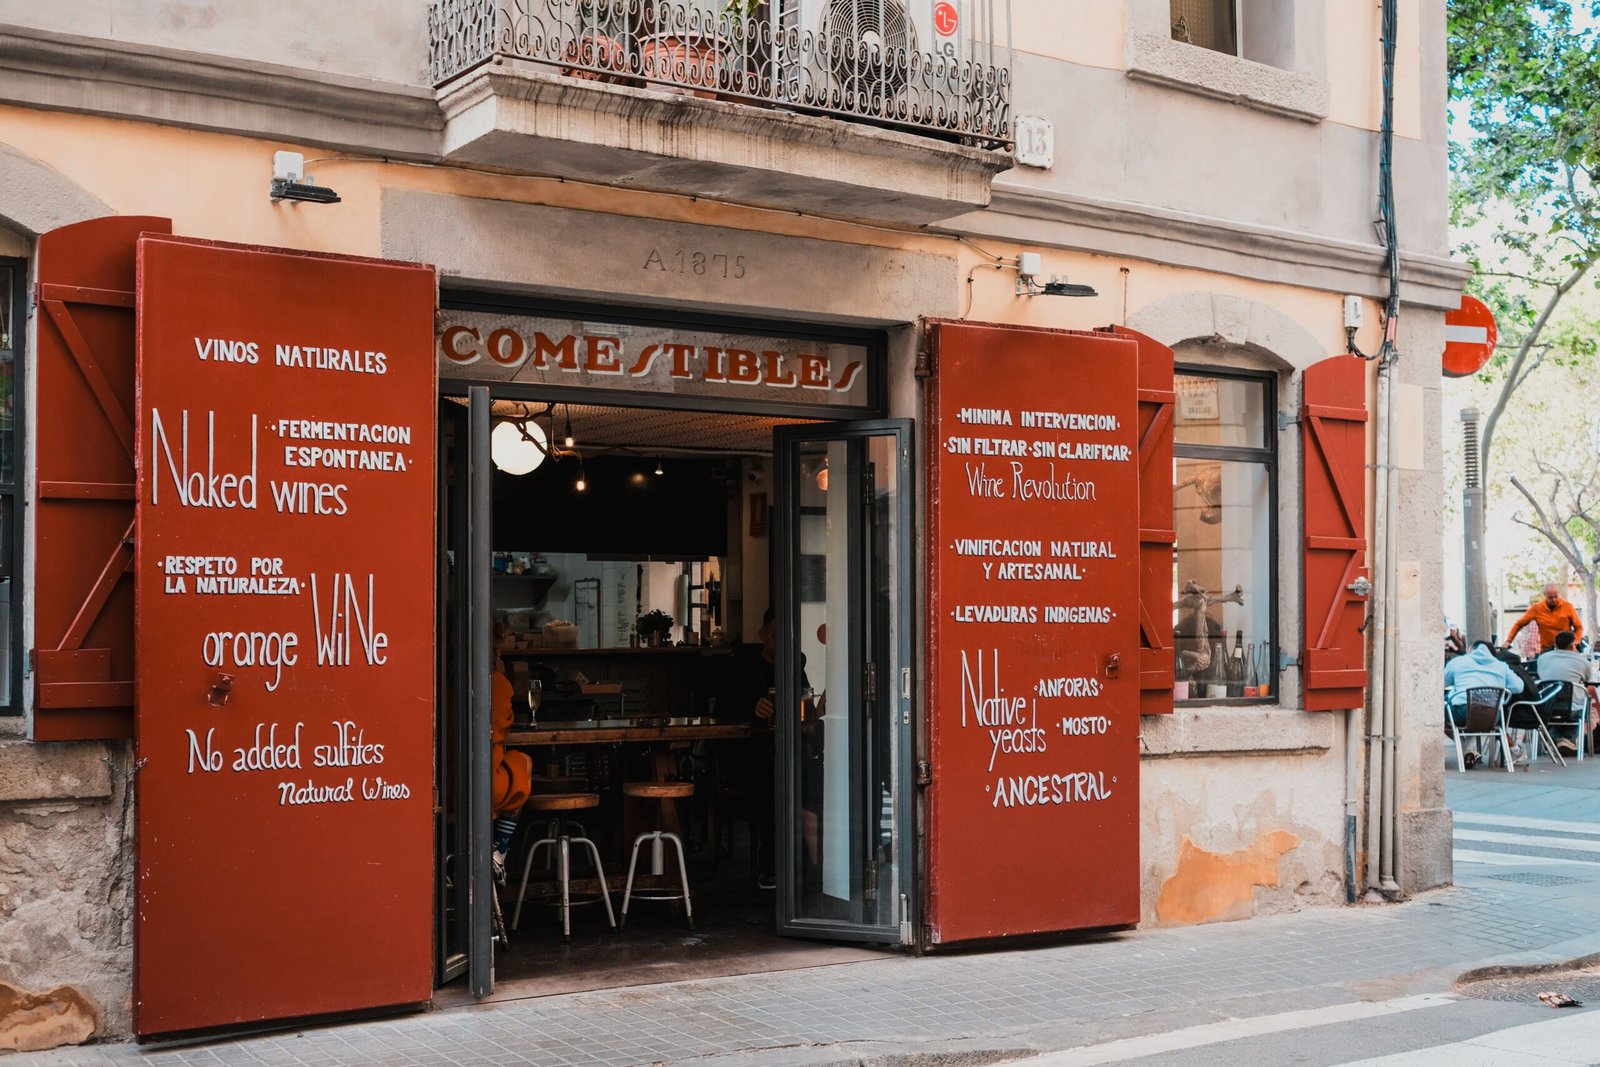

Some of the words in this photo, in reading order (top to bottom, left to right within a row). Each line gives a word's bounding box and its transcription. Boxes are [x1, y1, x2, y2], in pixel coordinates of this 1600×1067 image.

[935, 40, 954, 57] LG
[1025, 127, 1046, 155] 13
[195, 338, 259, 364] VINOS
[276, 345, 387, 375] NATURALES
[441, 325, 863, 392] COMESTIBLES
[279, 419, 410, 444] FERMENTACION
[961, 408, 1012, 426] MINIMA
[1021, 411, 1116, 431] INTERVENCION
[152, 407, 257, 508] Naked
[285, 446, 406, 471] ESPONTANEA
[948, 437, 971, 454] SIN
[975, 438, 1028, 457] FILTRAR
[1033, 441, 1055, 458] SIN
[1058, 443, 1129, 461] CLARIFICAR
[965, 462, 1005, 497] Wine
[1010, 462, 1096, 501] Revolution
[955, 539, 1042, 557] VINIFICACION
[1051, 541, 1117, 558] NATURAL
[165, 556, 237, 575] RESPETO
[251, 557, 283, 576] POR
[983, 562, 993, 580] Y
[998, 563, 1082, 580] ARTESANAL
[165, 577, 186, 594] LA
[196, 577, 299, 595] NATURALEZA
[956, 606, 1038, 624] LEVADURAS
[1045, 607, 1111, 624] INDIGENAS
[203, 632, 298, 692] orange
[961, 648, 1026, 728] Native
[1039, 678, 1099, 697] ANFORAS
[986, 697, 1046, 772] yeasts
[1062, 716, 1106, 735] MOSTO
[186, 728, 223, 773] No
[232, 722, 304, 772] added
[313, 721, 384, 767] sulfites
[362, 777, 410, 800] Wines
[992, 771, 1111, 808] ANCESTRAL
